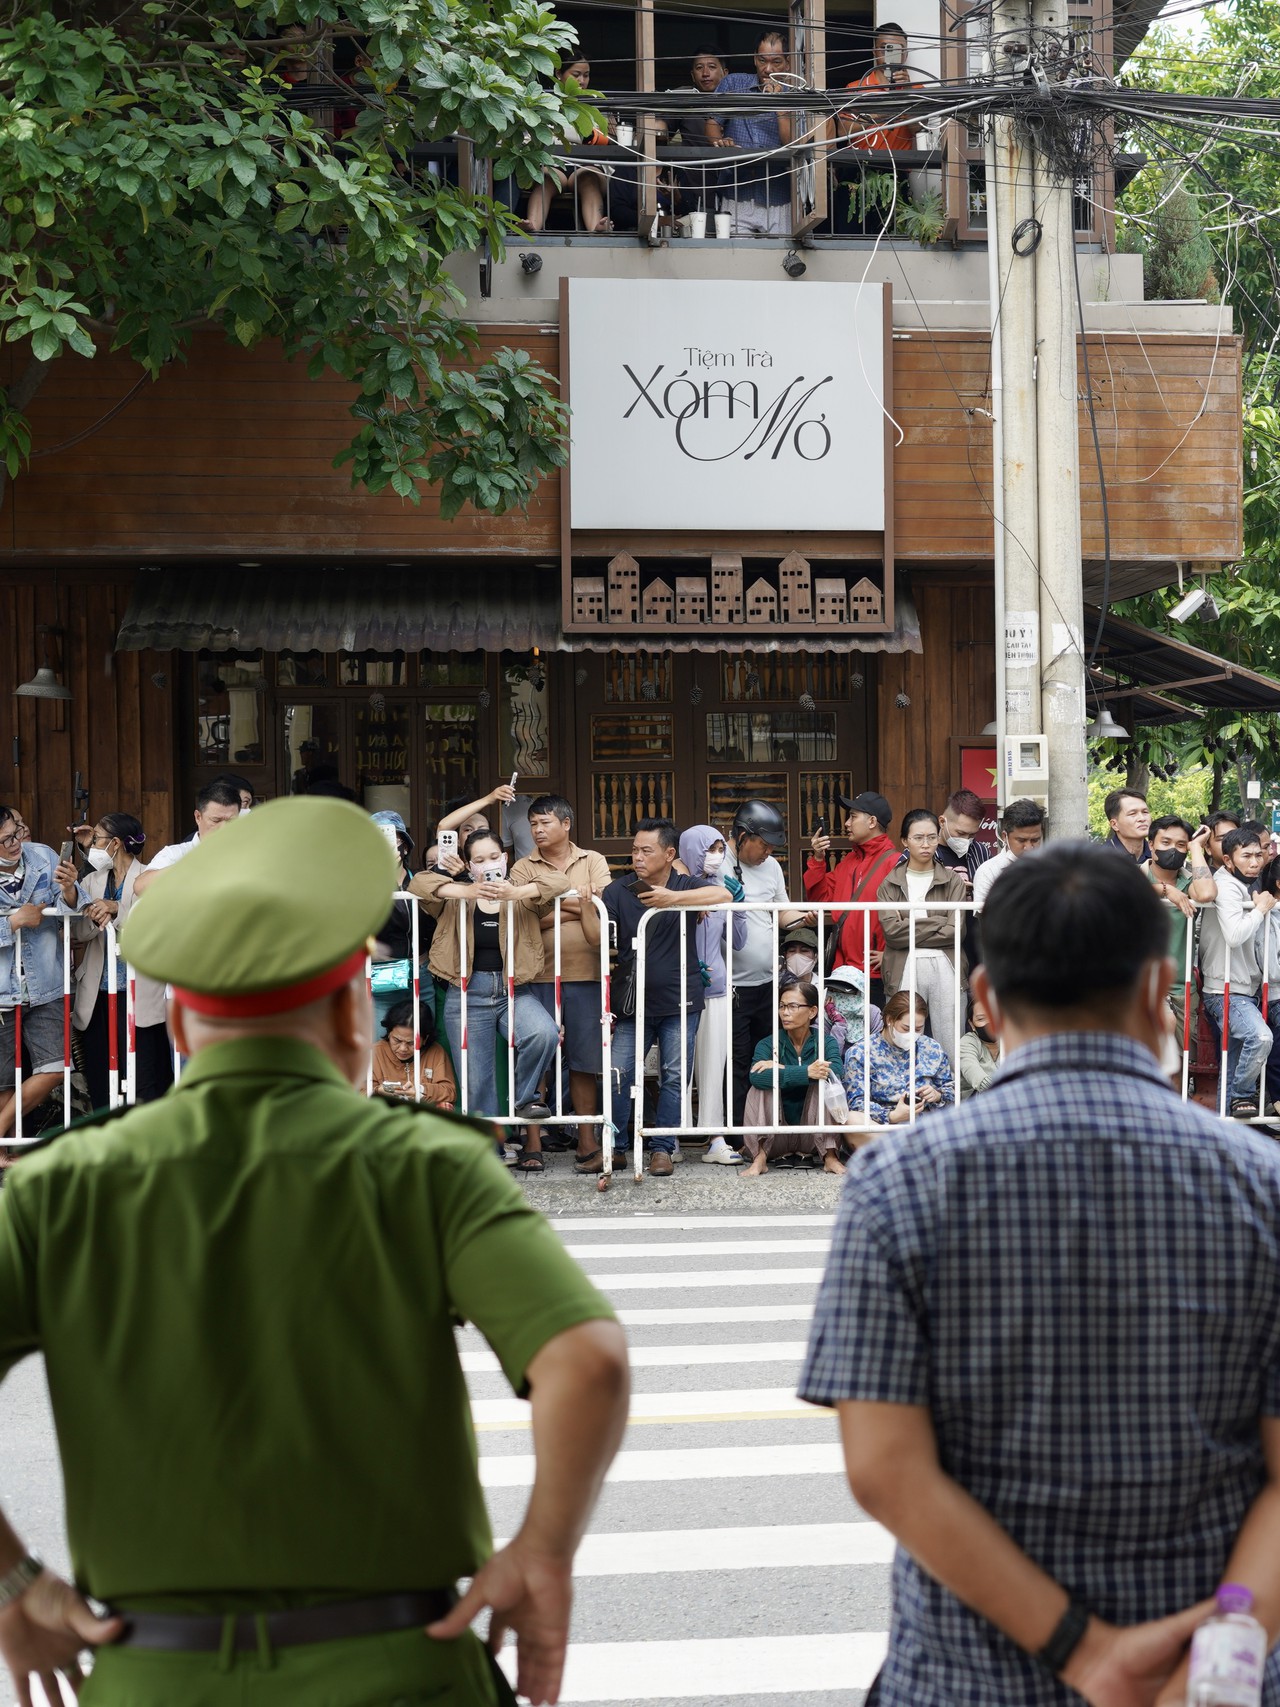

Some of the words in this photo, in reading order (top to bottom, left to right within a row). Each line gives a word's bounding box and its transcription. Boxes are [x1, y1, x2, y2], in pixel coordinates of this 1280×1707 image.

[683, 347, 735, 370] Tiệm
[741, 348, 773, 368] Trà
[622, 364, 759, 420] Xóm
